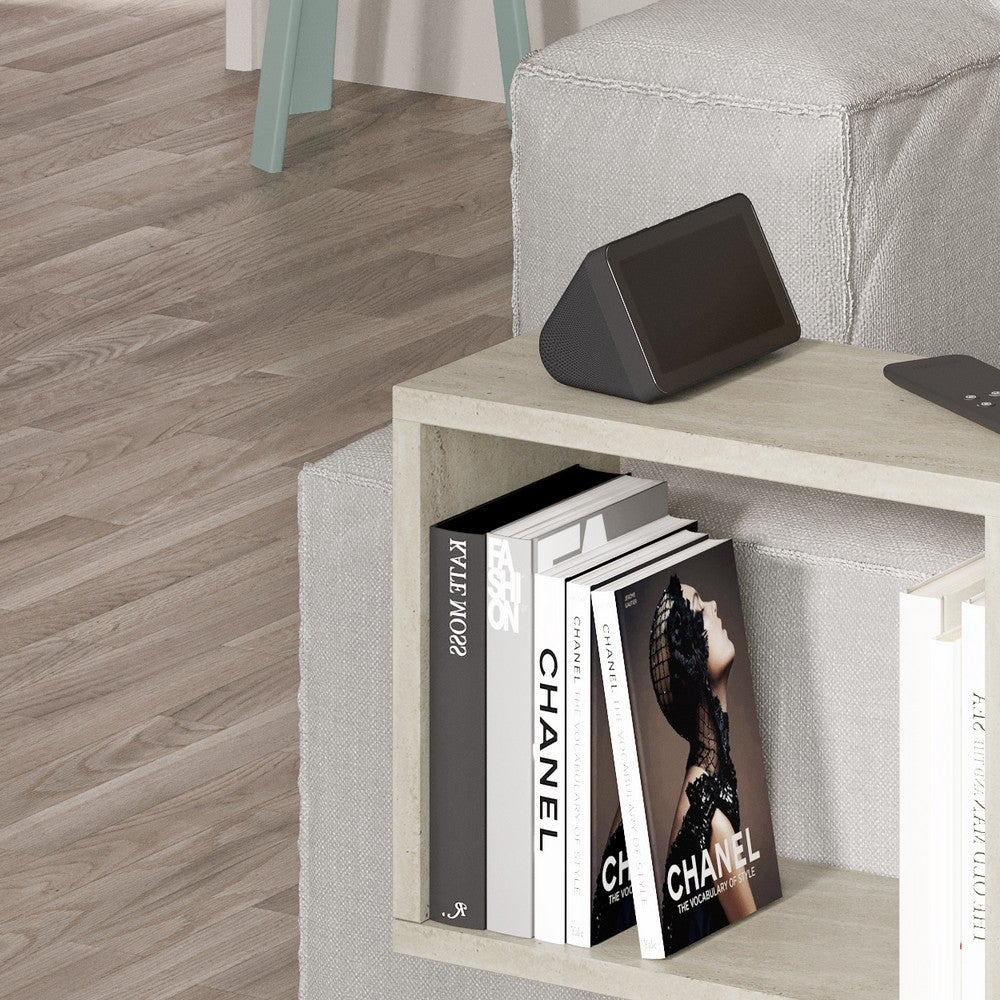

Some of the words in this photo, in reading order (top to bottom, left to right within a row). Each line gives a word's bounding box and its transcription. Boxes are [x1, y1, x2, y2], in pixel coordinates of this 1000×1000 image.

[573, 616, 582, 684] CHANEL
[602, 624, 617, 692] CHANEL
[539, 648, 558, 851] CHANEL
[608, 890, 620, 905] THE
[667, 828, 761, 901] CHANEL
[677, 901, 690, 914] THE
[689, 883, 728, 908] VOCABULARY
[729, 877, 737, 889] OF
[739, 867, 755, 884] STYLE
